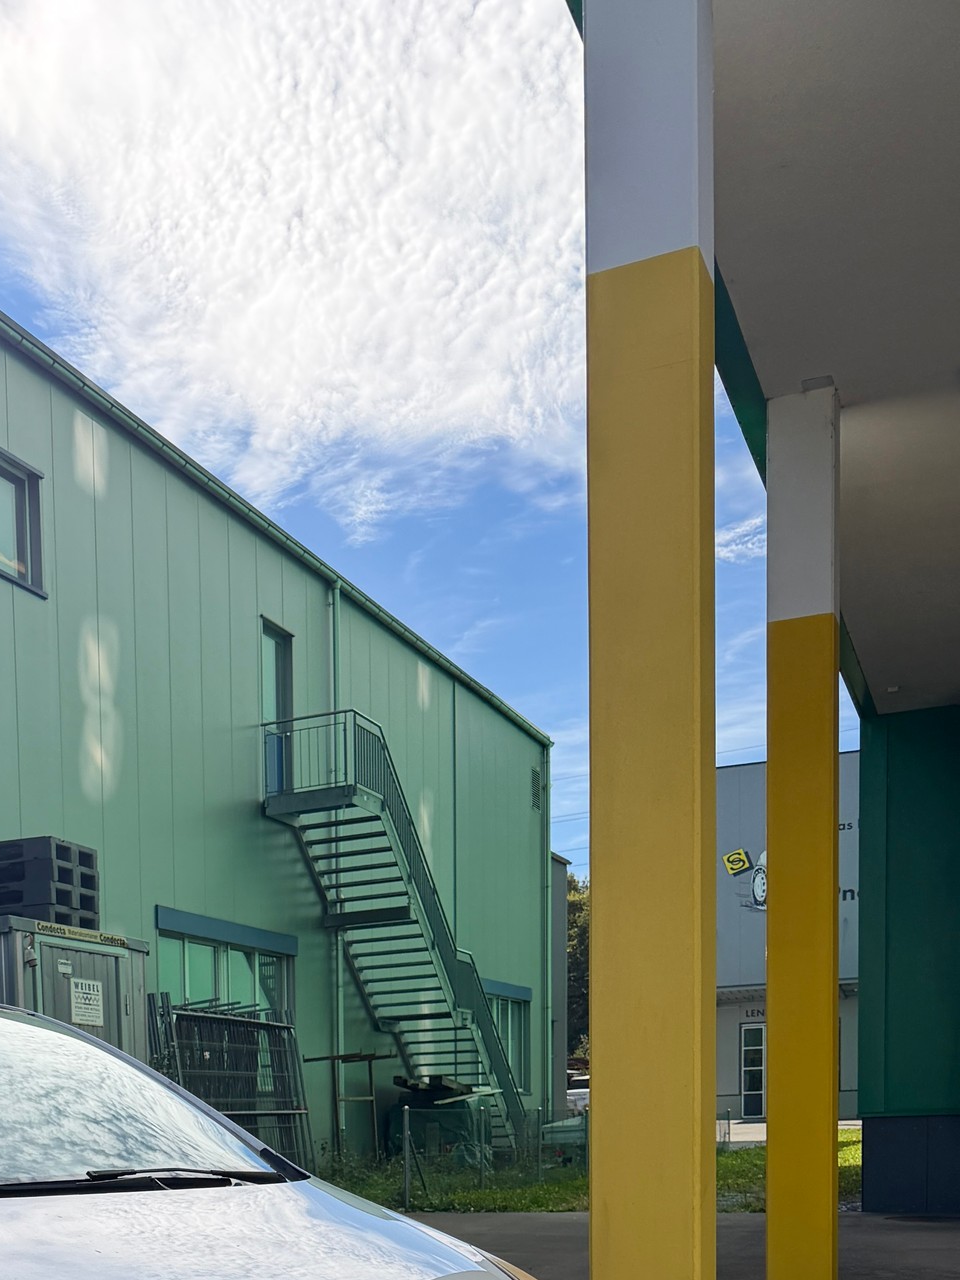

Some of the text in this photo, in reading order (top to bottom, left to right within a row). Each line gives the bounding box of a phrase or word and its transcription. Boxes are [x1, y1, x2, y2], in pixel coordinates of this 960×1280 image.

[37, 922, 66, 936] Condecta
[99, 933, 126, 947] Condecta
[74, 982, 100, 993] WEIBEL
